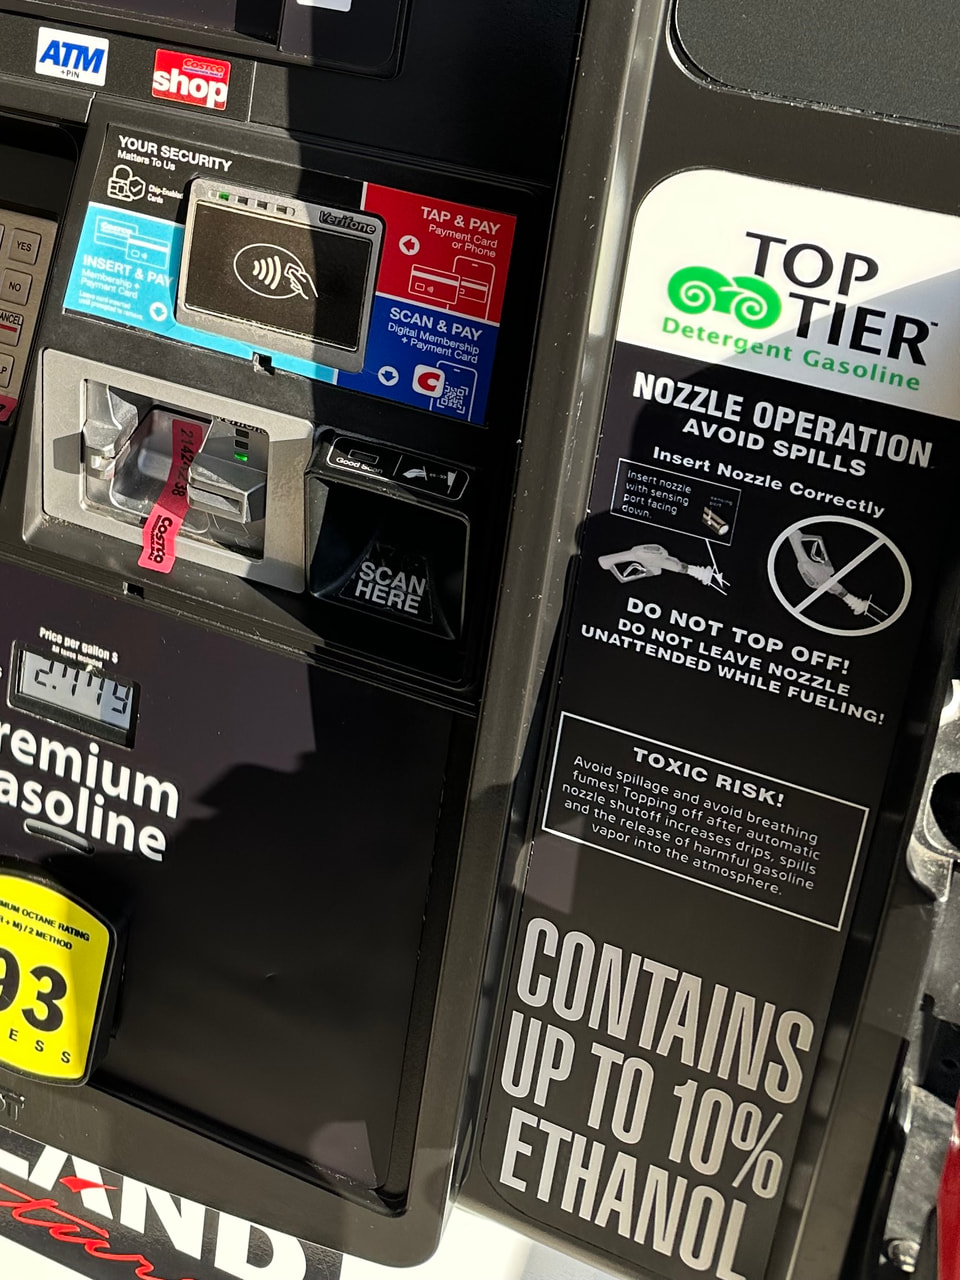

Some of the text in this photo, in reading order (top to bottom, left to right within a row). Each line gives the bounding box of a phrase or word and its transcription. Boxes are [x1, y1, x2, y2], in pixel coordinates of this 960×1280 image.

[38, 40, 106, 75] ATM
[183, 58, 225, 74] COSTCO
[153, 68, 227, 108] shop
[118, 134, 232, 171] YOUR SECURITY
[319, 210, 376, 235] Verifone
[420, 206, 500, 234] TAP & PAY
[428, 223, 497, 248] Payment Card
[16, 240, 32, 252] YES
[451, 241, 495, 257] or Phone
[745, 231, 879, 296] TOP
[8, 281, 22, 292] NO
[82, 253, 173, 289] INSERT & PAY
[388, 323, 480, 354] Digital Membership
[389, 307, 482, 340] SCAN & PAY
[661, 316, 922, 391] Detergent Gasoline
[632, 371, 932, 467] NOZZLE OPERATION
[682, 419, 865, 476] AVOID SPILLS
[653, 446, 884, 517] Insert Nozzle Correctly
[154, 516, 174, 564] COSTCO
[354, 583, 420, 614] HERE
[359, 562, 425, 596] SCAN
[626, 597, 849, 674] DO NOT TOP OFF!
[581, 625, 884, 724] UNATTENDED WHILE FUELING!
[618, 618, 849, 696] DO NOT LEAVE NOZZLE
[633, 746, 783, 807] TOXIC RISK!
[573, 756, 817, 845] Avoid spillage and avoid breathing
[517, 917, 814, 1104] CONTAINS
[500, 1010, 784, 1200] UP TO 10%
[498, 1106, 748, 1280] ETHANOL
